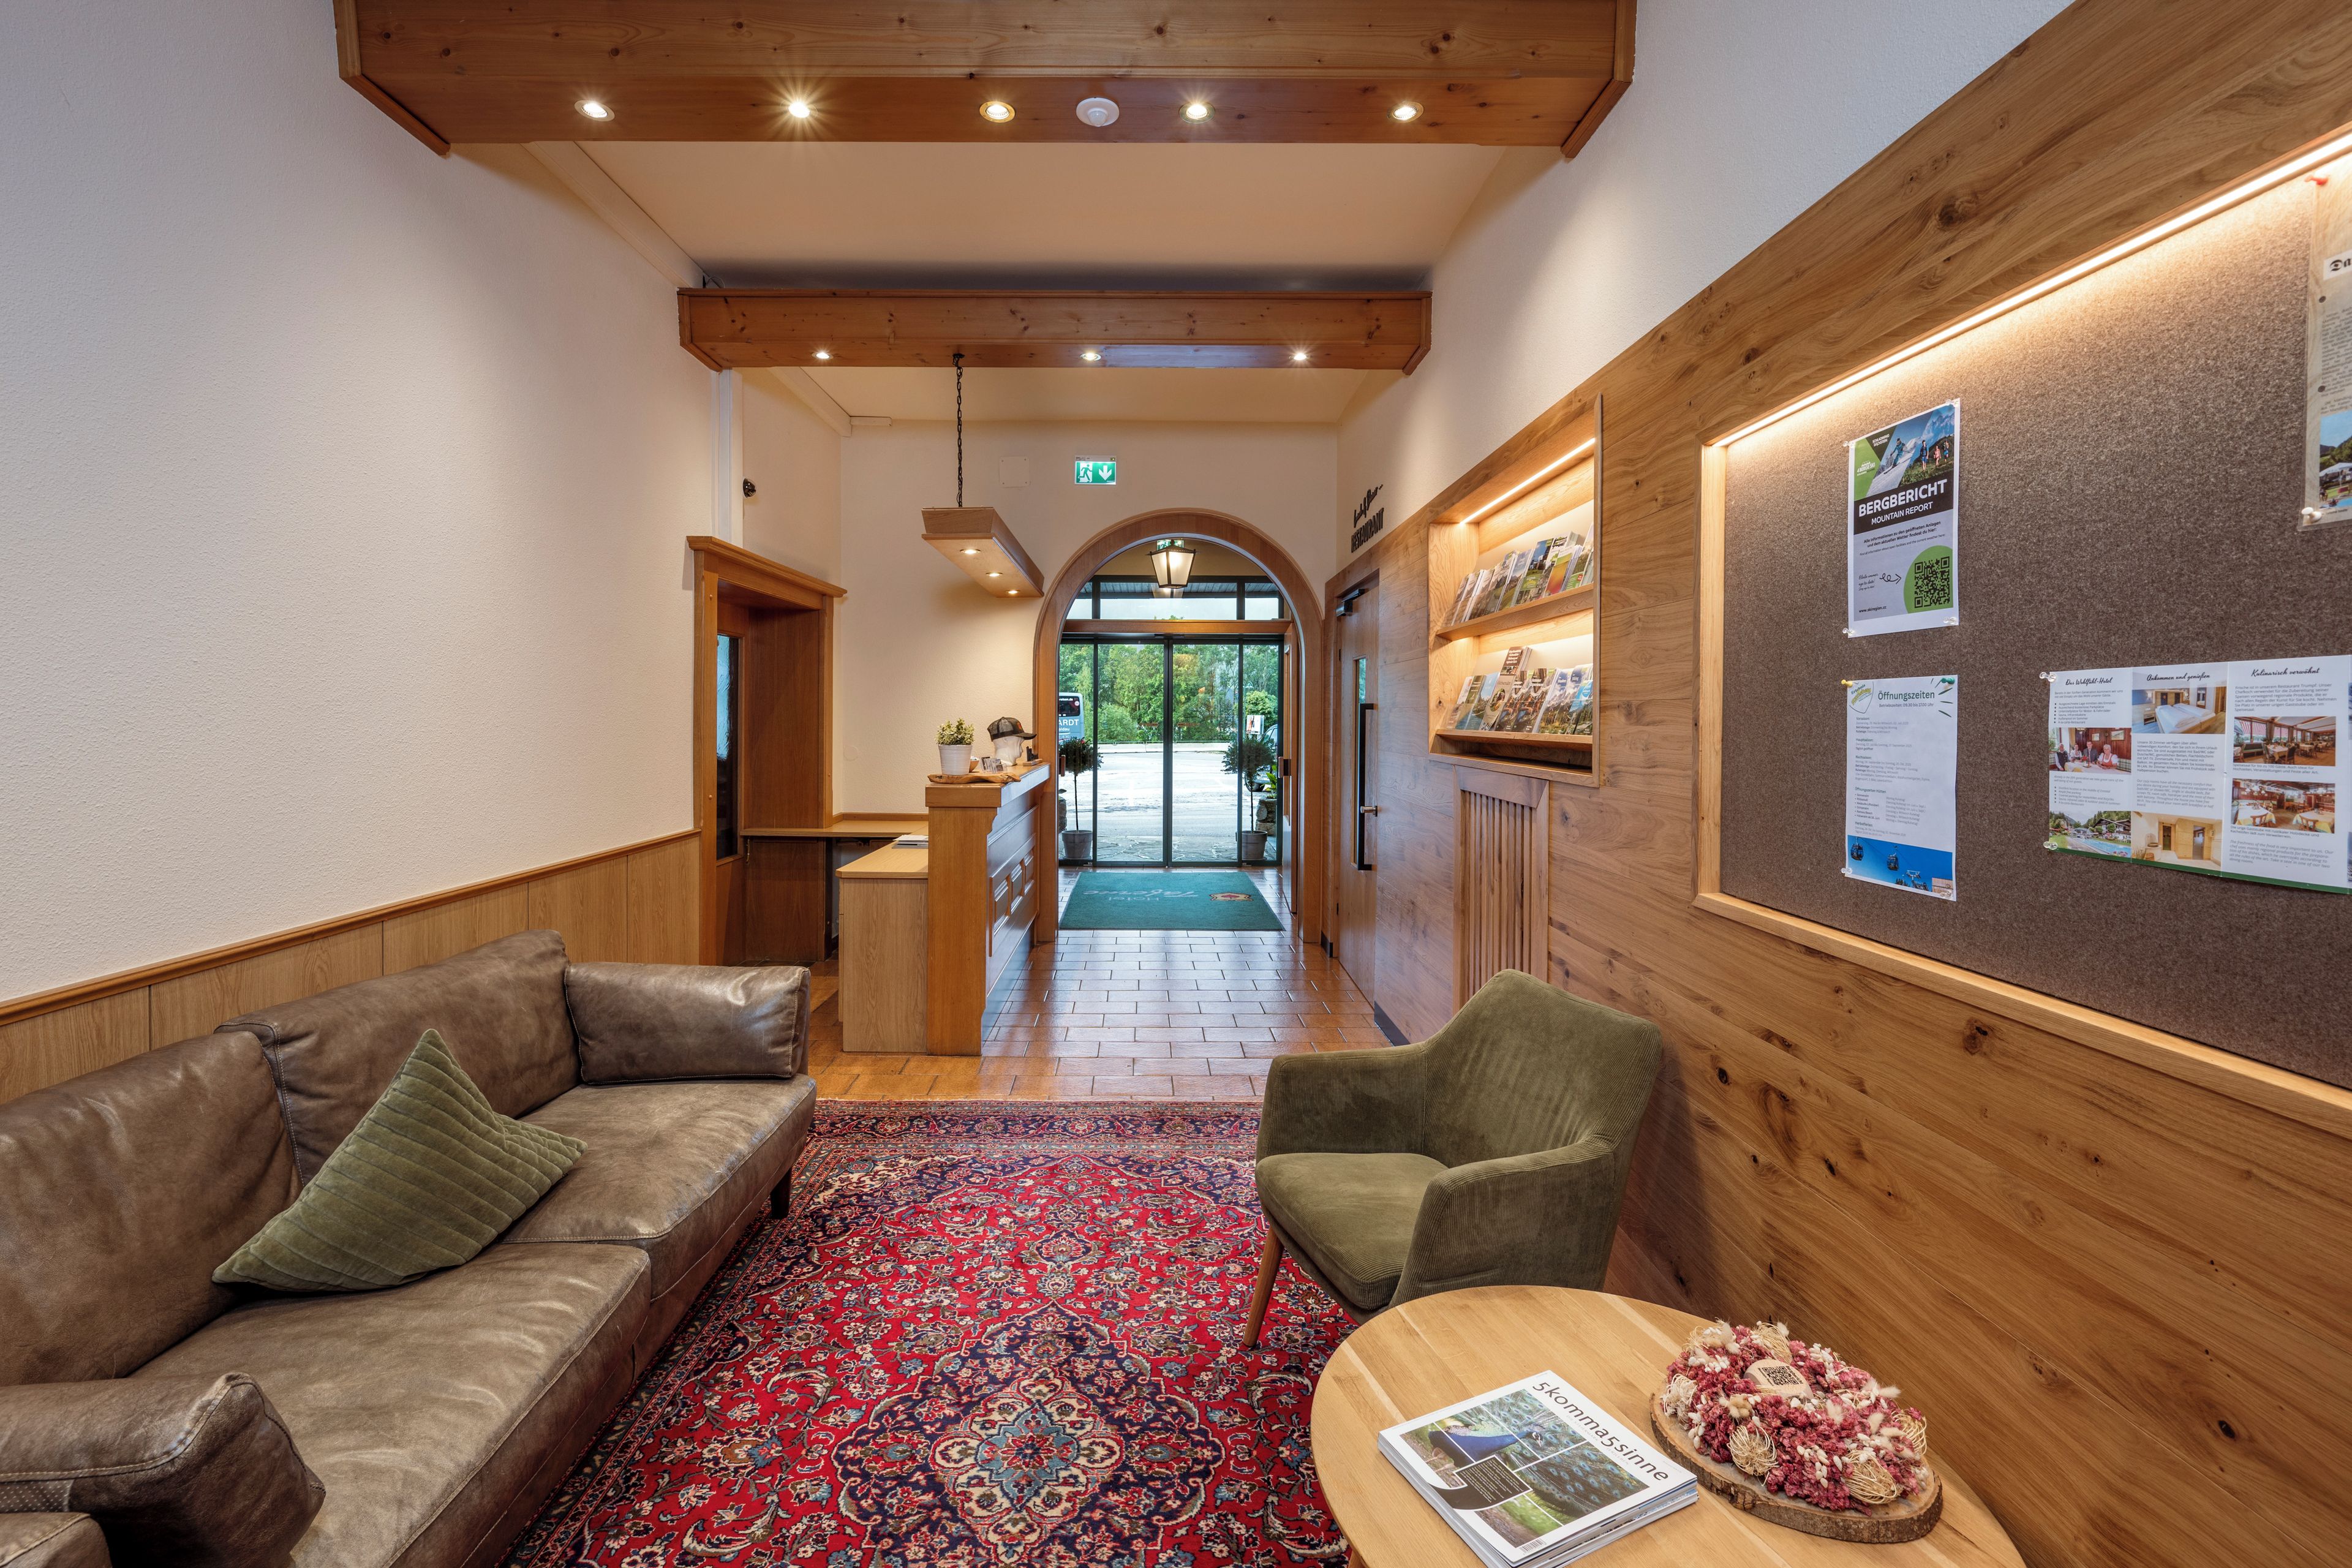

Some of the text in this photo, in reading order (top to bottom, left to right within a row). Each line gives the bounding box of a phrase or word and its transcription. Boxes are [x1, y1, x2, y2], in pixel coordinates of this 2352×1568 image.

[1858, 479, 1947, 517] BERGBERICHT
[1871, 502, 1933, 525] MOUNTAIN REPORT
[1351, 508, 1384, 553] RESTAURANT
[1871, 532, 1893, 541] Informationen
[1905, 524, 1924, 534] geöffneten
[1925, 521, 1940, 529] Anlagen
[2076, 677, 2113, 686] Wohlfühl-Hotel
[2187, 672, 2210, 681] genießen
[2251, 666, 2320, 677] Kulinarisch verwöhnt
[1878, 690, 1935, 701] Öffnungszeiten
[1532, 1382, 1668, 1481] 5komma5sinne
